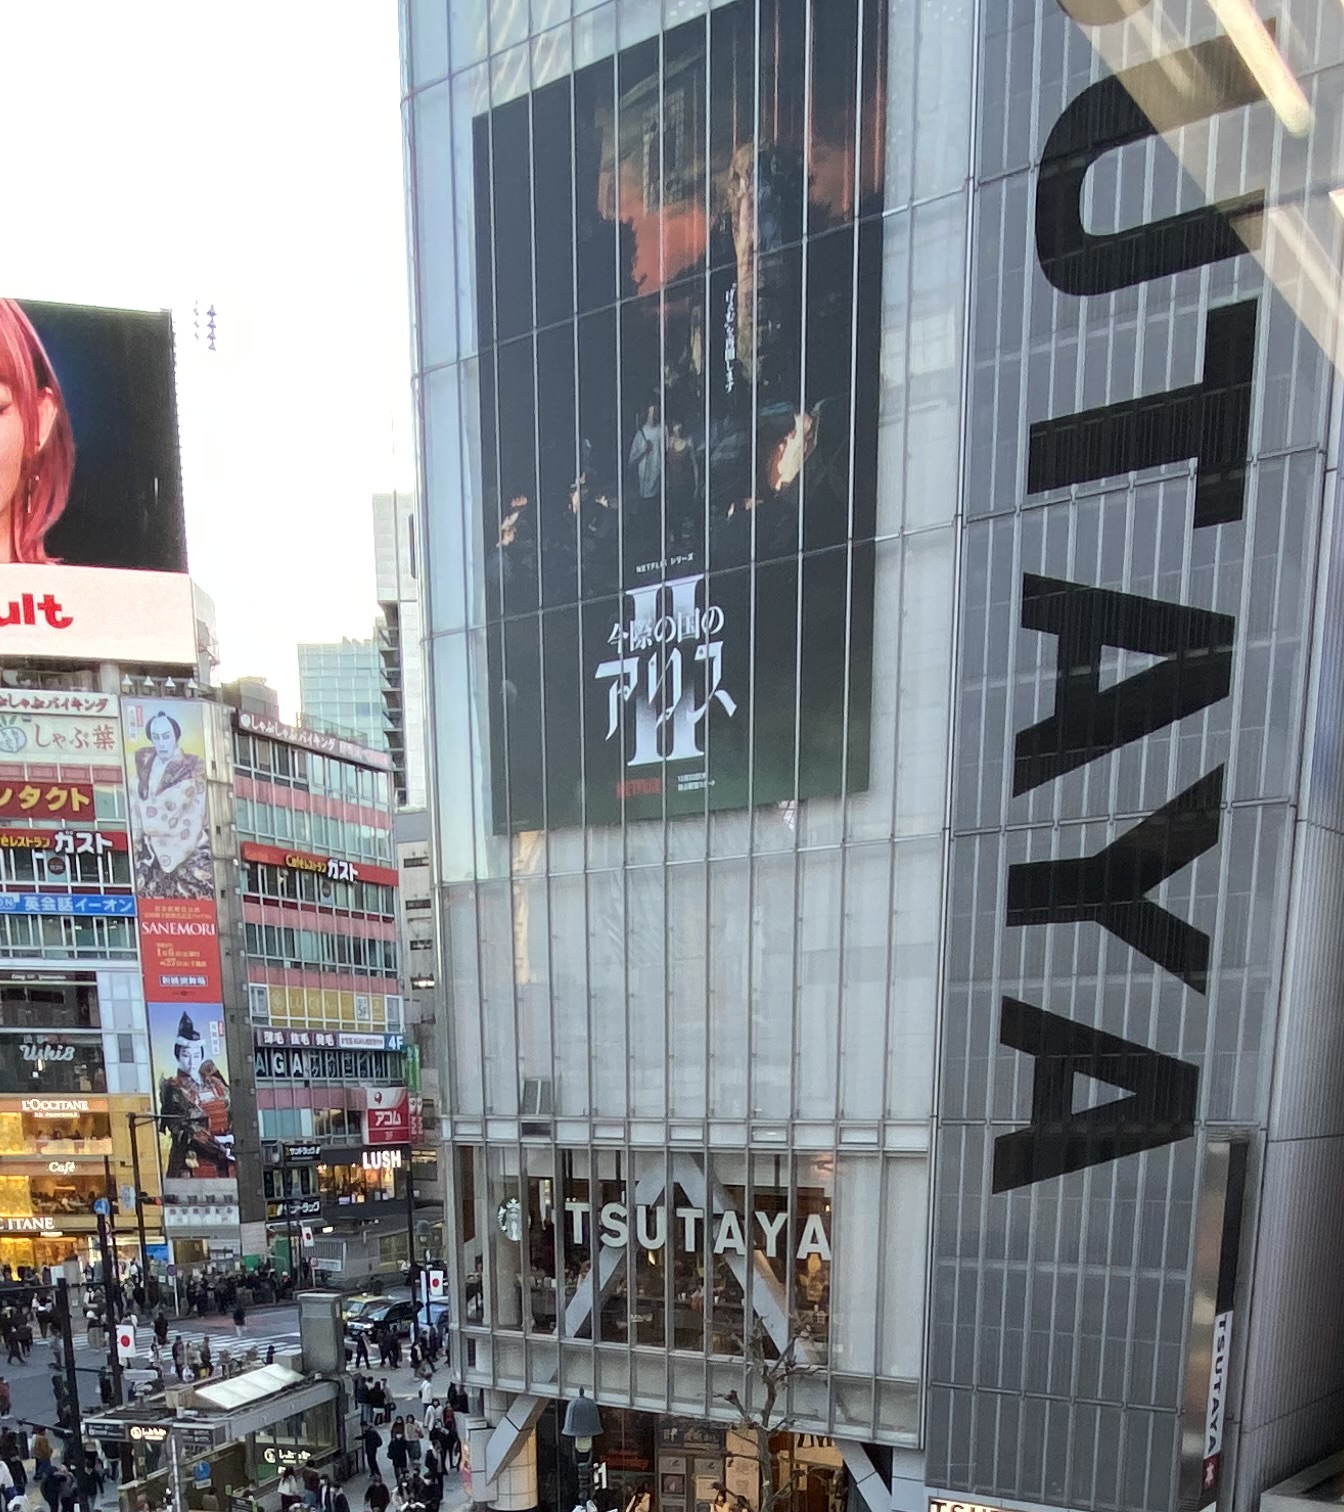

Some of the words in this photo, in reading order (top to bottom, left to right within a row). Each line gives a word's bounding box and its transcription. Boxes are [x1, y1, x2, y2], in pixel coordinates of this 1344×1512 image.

[635, 560, 667, 573] NETFLX
[607, 606, 725, 654] 今際の国の
[595, 641, 738, 741] アリス
[33, 723, 116, 751] しゃぶ葉
[54, 830, 113, 855] ガスト
[327, 858, 359, 883] ガスト
[23, 895, 133, 912] 英会話イーオン
[141, 921, 216, 936] SANEMORI
[388, 1035, 404, 1050] 4F
[256, 1052, 304, 1075] AGA
[21, 1098, 89, 1111] L'OCCITANE
[374, 1111, 401, 1126] アコム
[49, 1161, 75, 1175] Café
[362, 1150, 402, 1169] LUSH
[564, 1201, 832, 1261] TSUTAYA
[1205, 1314, 1228, 1454] TSUTAYA
